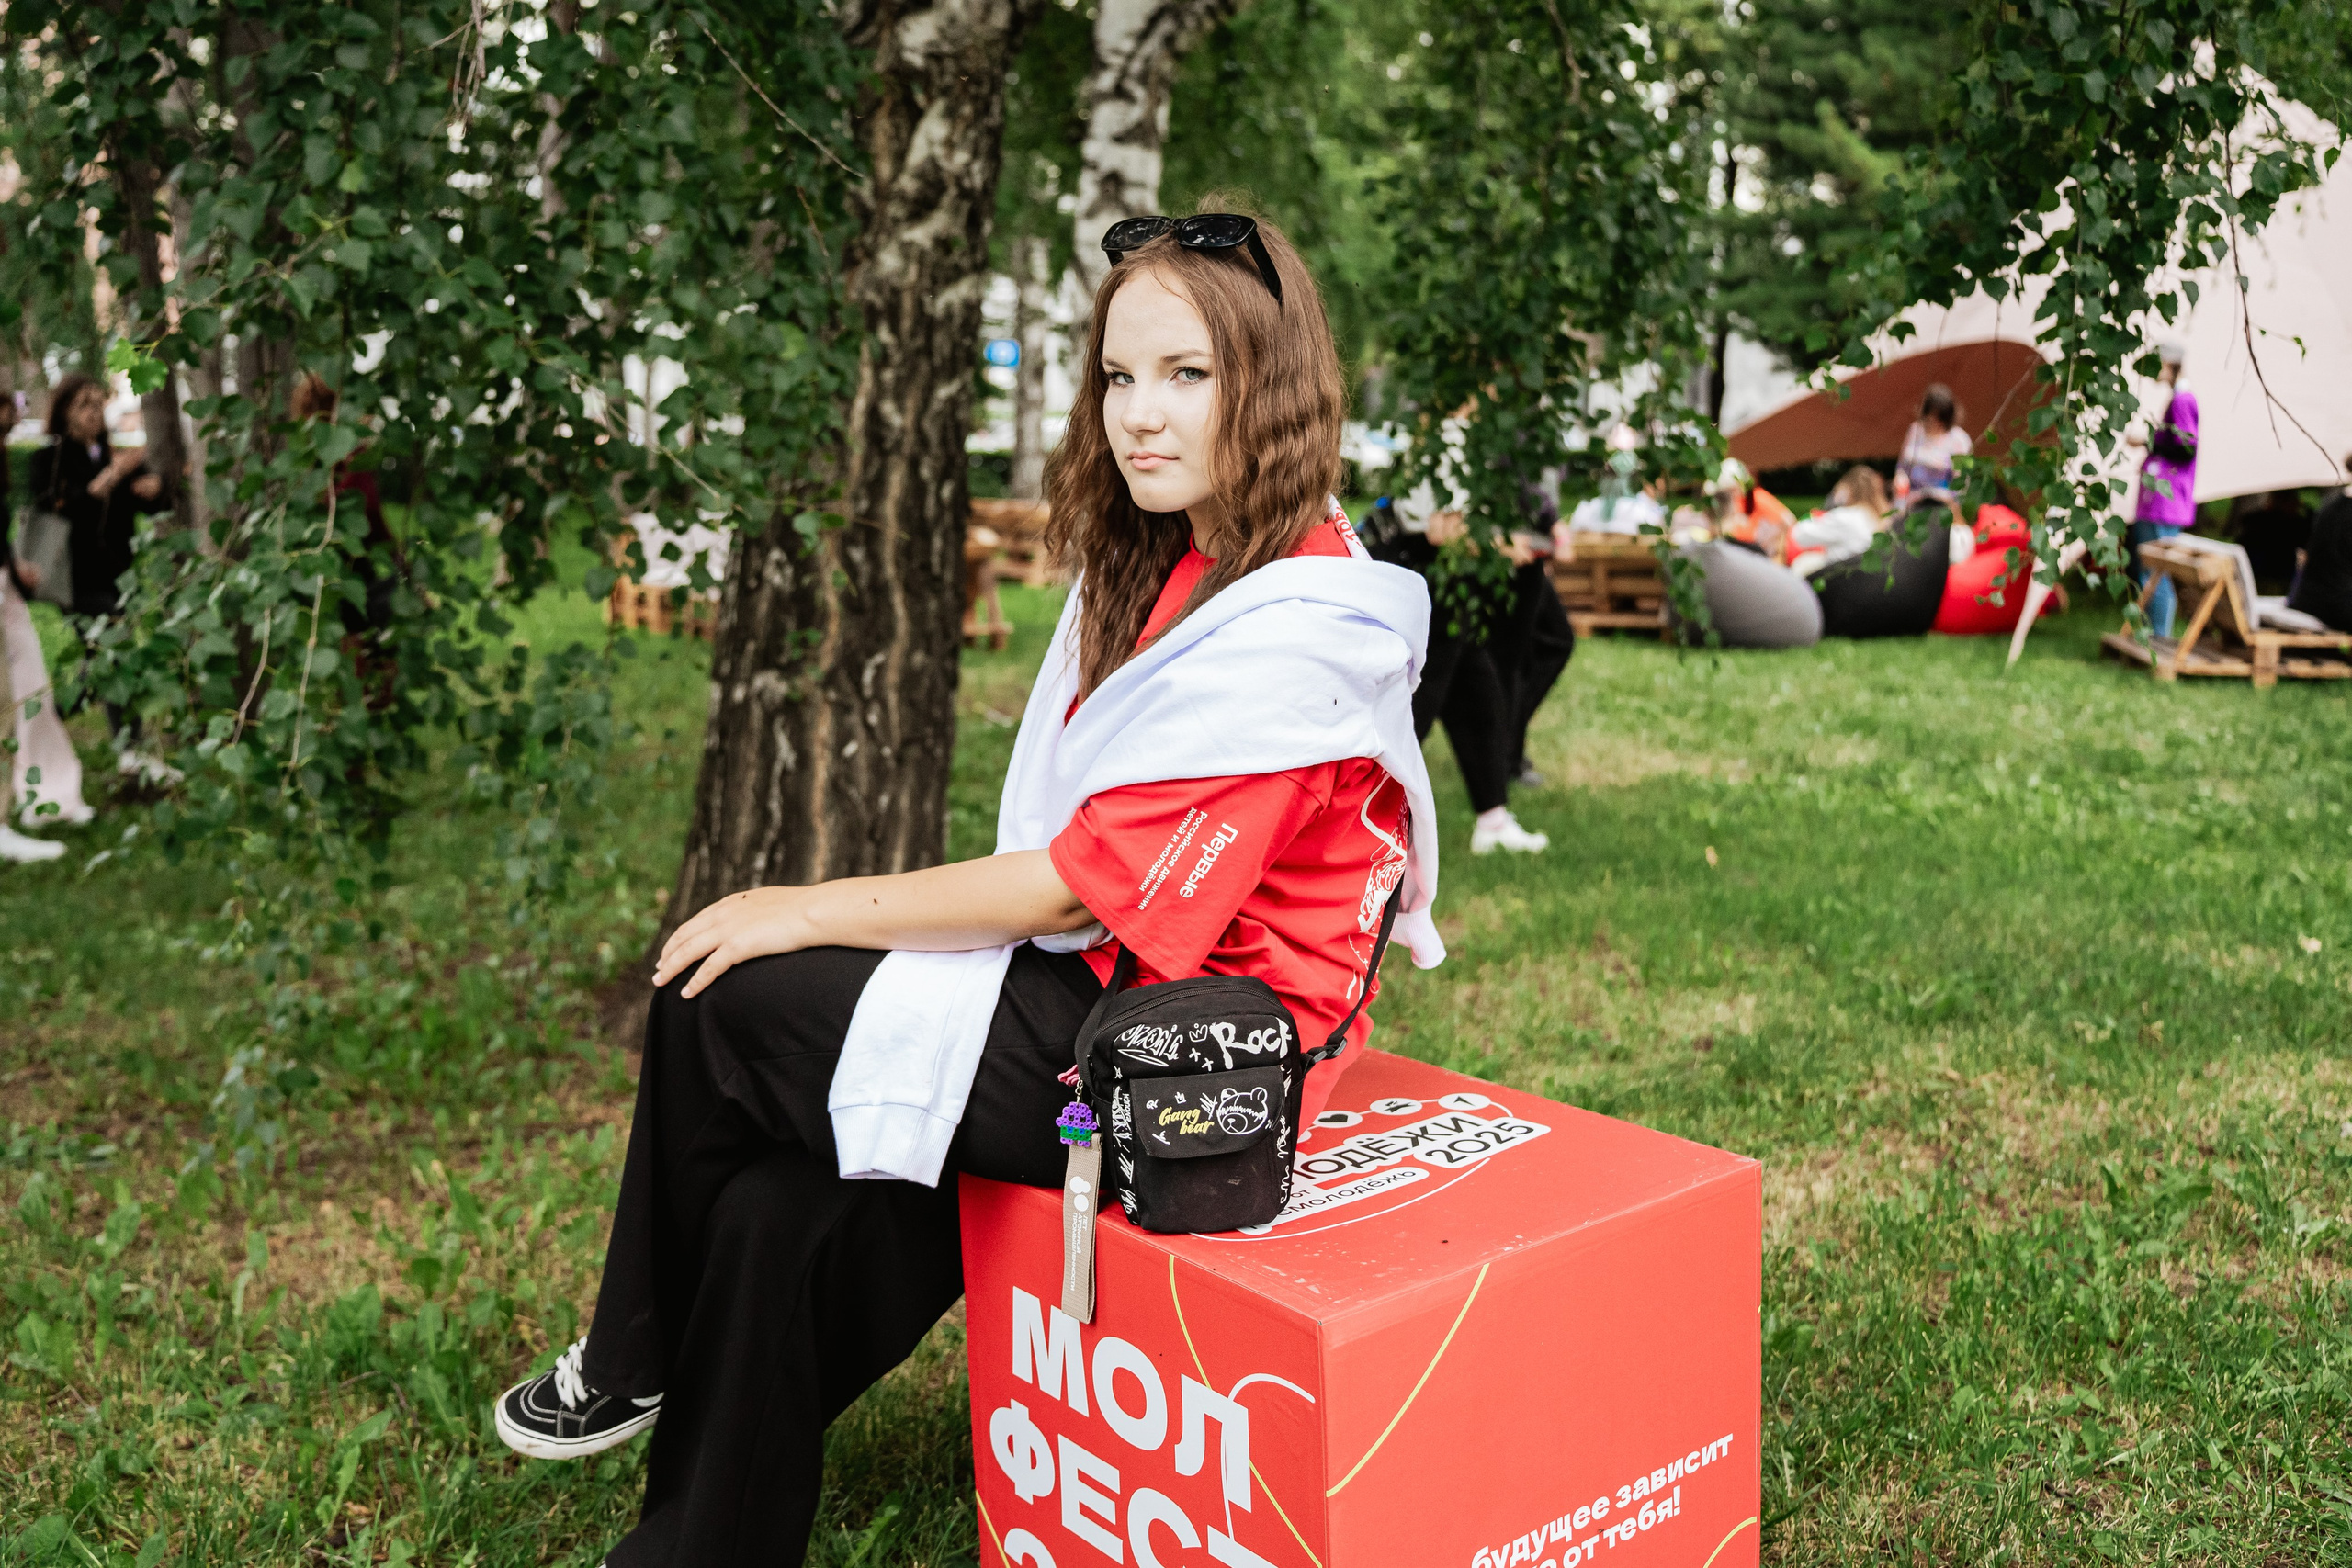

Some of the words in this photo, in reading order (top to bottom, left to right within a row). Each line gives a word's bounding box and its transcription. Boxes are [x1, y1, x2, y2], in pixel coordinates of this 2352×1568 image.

[1168, 811, 1208, 867] Российское
[1171, 834, 1180, 843] и
[1177, 807, 1197, 834] детей
[1138, 842, 1173, 892] молодёжи
[1180, 823, 1238, 897] Первые
[1138, 866, 1170, 910] движение
[1159, 1107, 1201, 1126] Gang
[1180, 1119, 1215, 1134] bear
[1425, 1125, 1534, 1164] 2025
[1070, 1213, 1079, 1292] ПРОМЫШЛЕННОСТИ
[1012, 1286, 1251, 1513] МОЛ
[1471, 1496, 1611, 1568] будущее
[1615, 1433, 1734, 1509] зависит
[1563, 1535, 1599, 1568] от
[1603, 1485, 1681, 1549] тебя!
